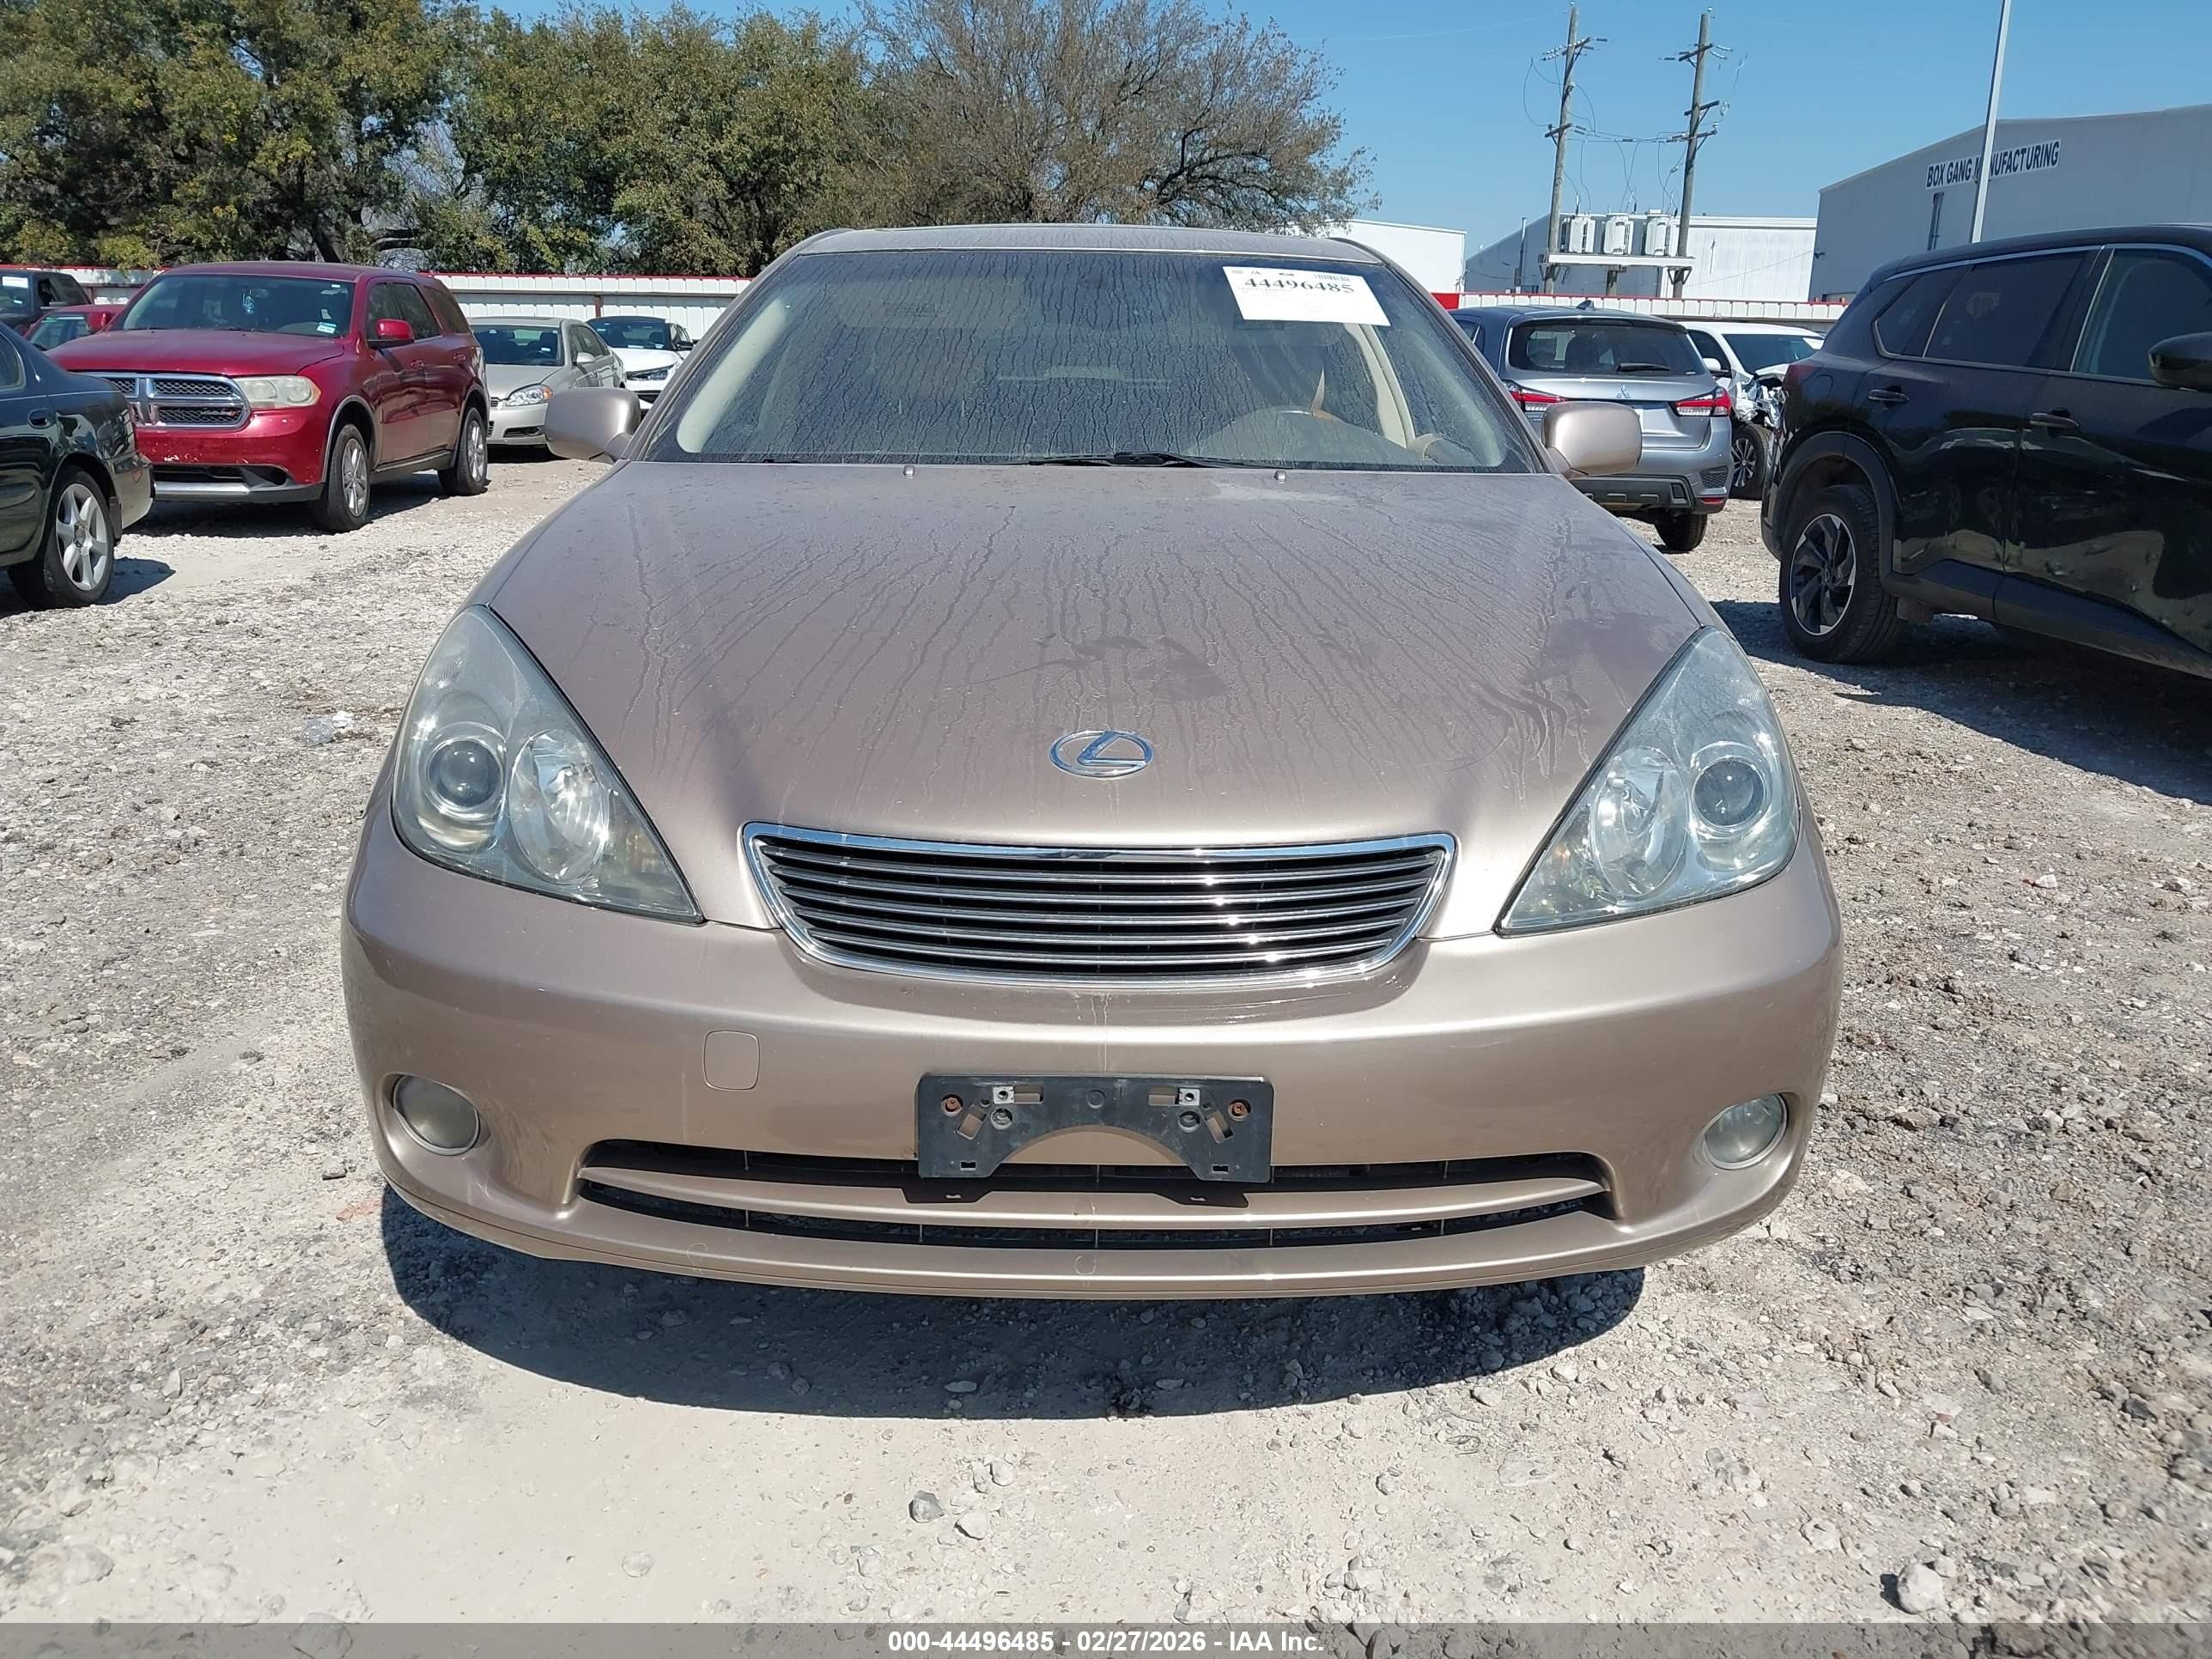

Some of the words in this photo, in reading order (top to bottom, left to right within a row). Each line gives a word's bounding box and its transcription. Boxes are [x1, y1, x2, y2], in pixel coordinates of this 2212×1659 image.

[1926, 164, 1946, 188] BOX
[1946, 158, 1972, 184] GANG
[1974, 141, 2060, 179] MNUFACTURING
[1244, 277, 1355, 294] 44496485
